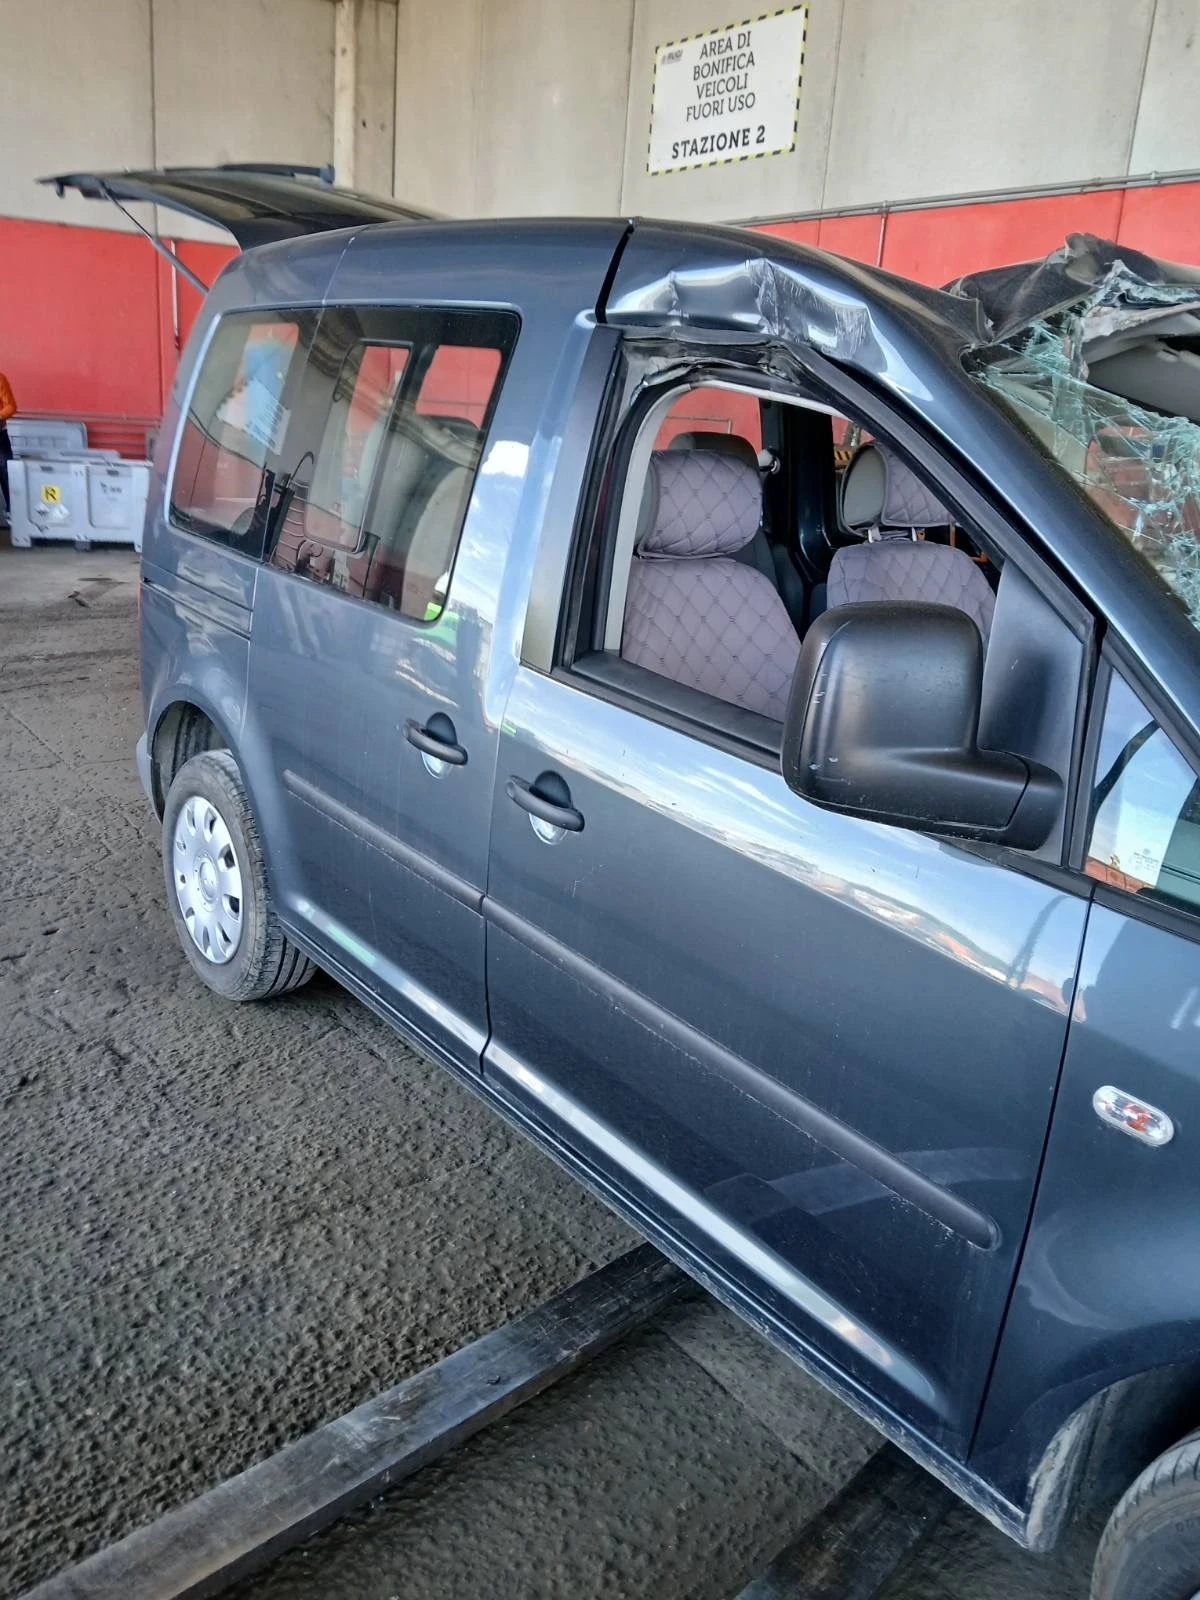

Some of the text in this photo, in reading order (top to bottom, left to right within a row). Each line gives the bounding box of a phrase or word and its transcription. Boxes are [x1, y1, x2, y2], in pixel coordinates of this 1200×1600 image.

[700, 37, 733, 60] AREA
[737, 31, 752, 50] DI
[693, 51, 755, 81] BONIFICA
[696, 73, 748, 100] VEICOLI
[686, 92, 756, 122] FUORI USO
[672, 125, 765, 159] STAZIONE 2
[45, 486, 57, 501] R
